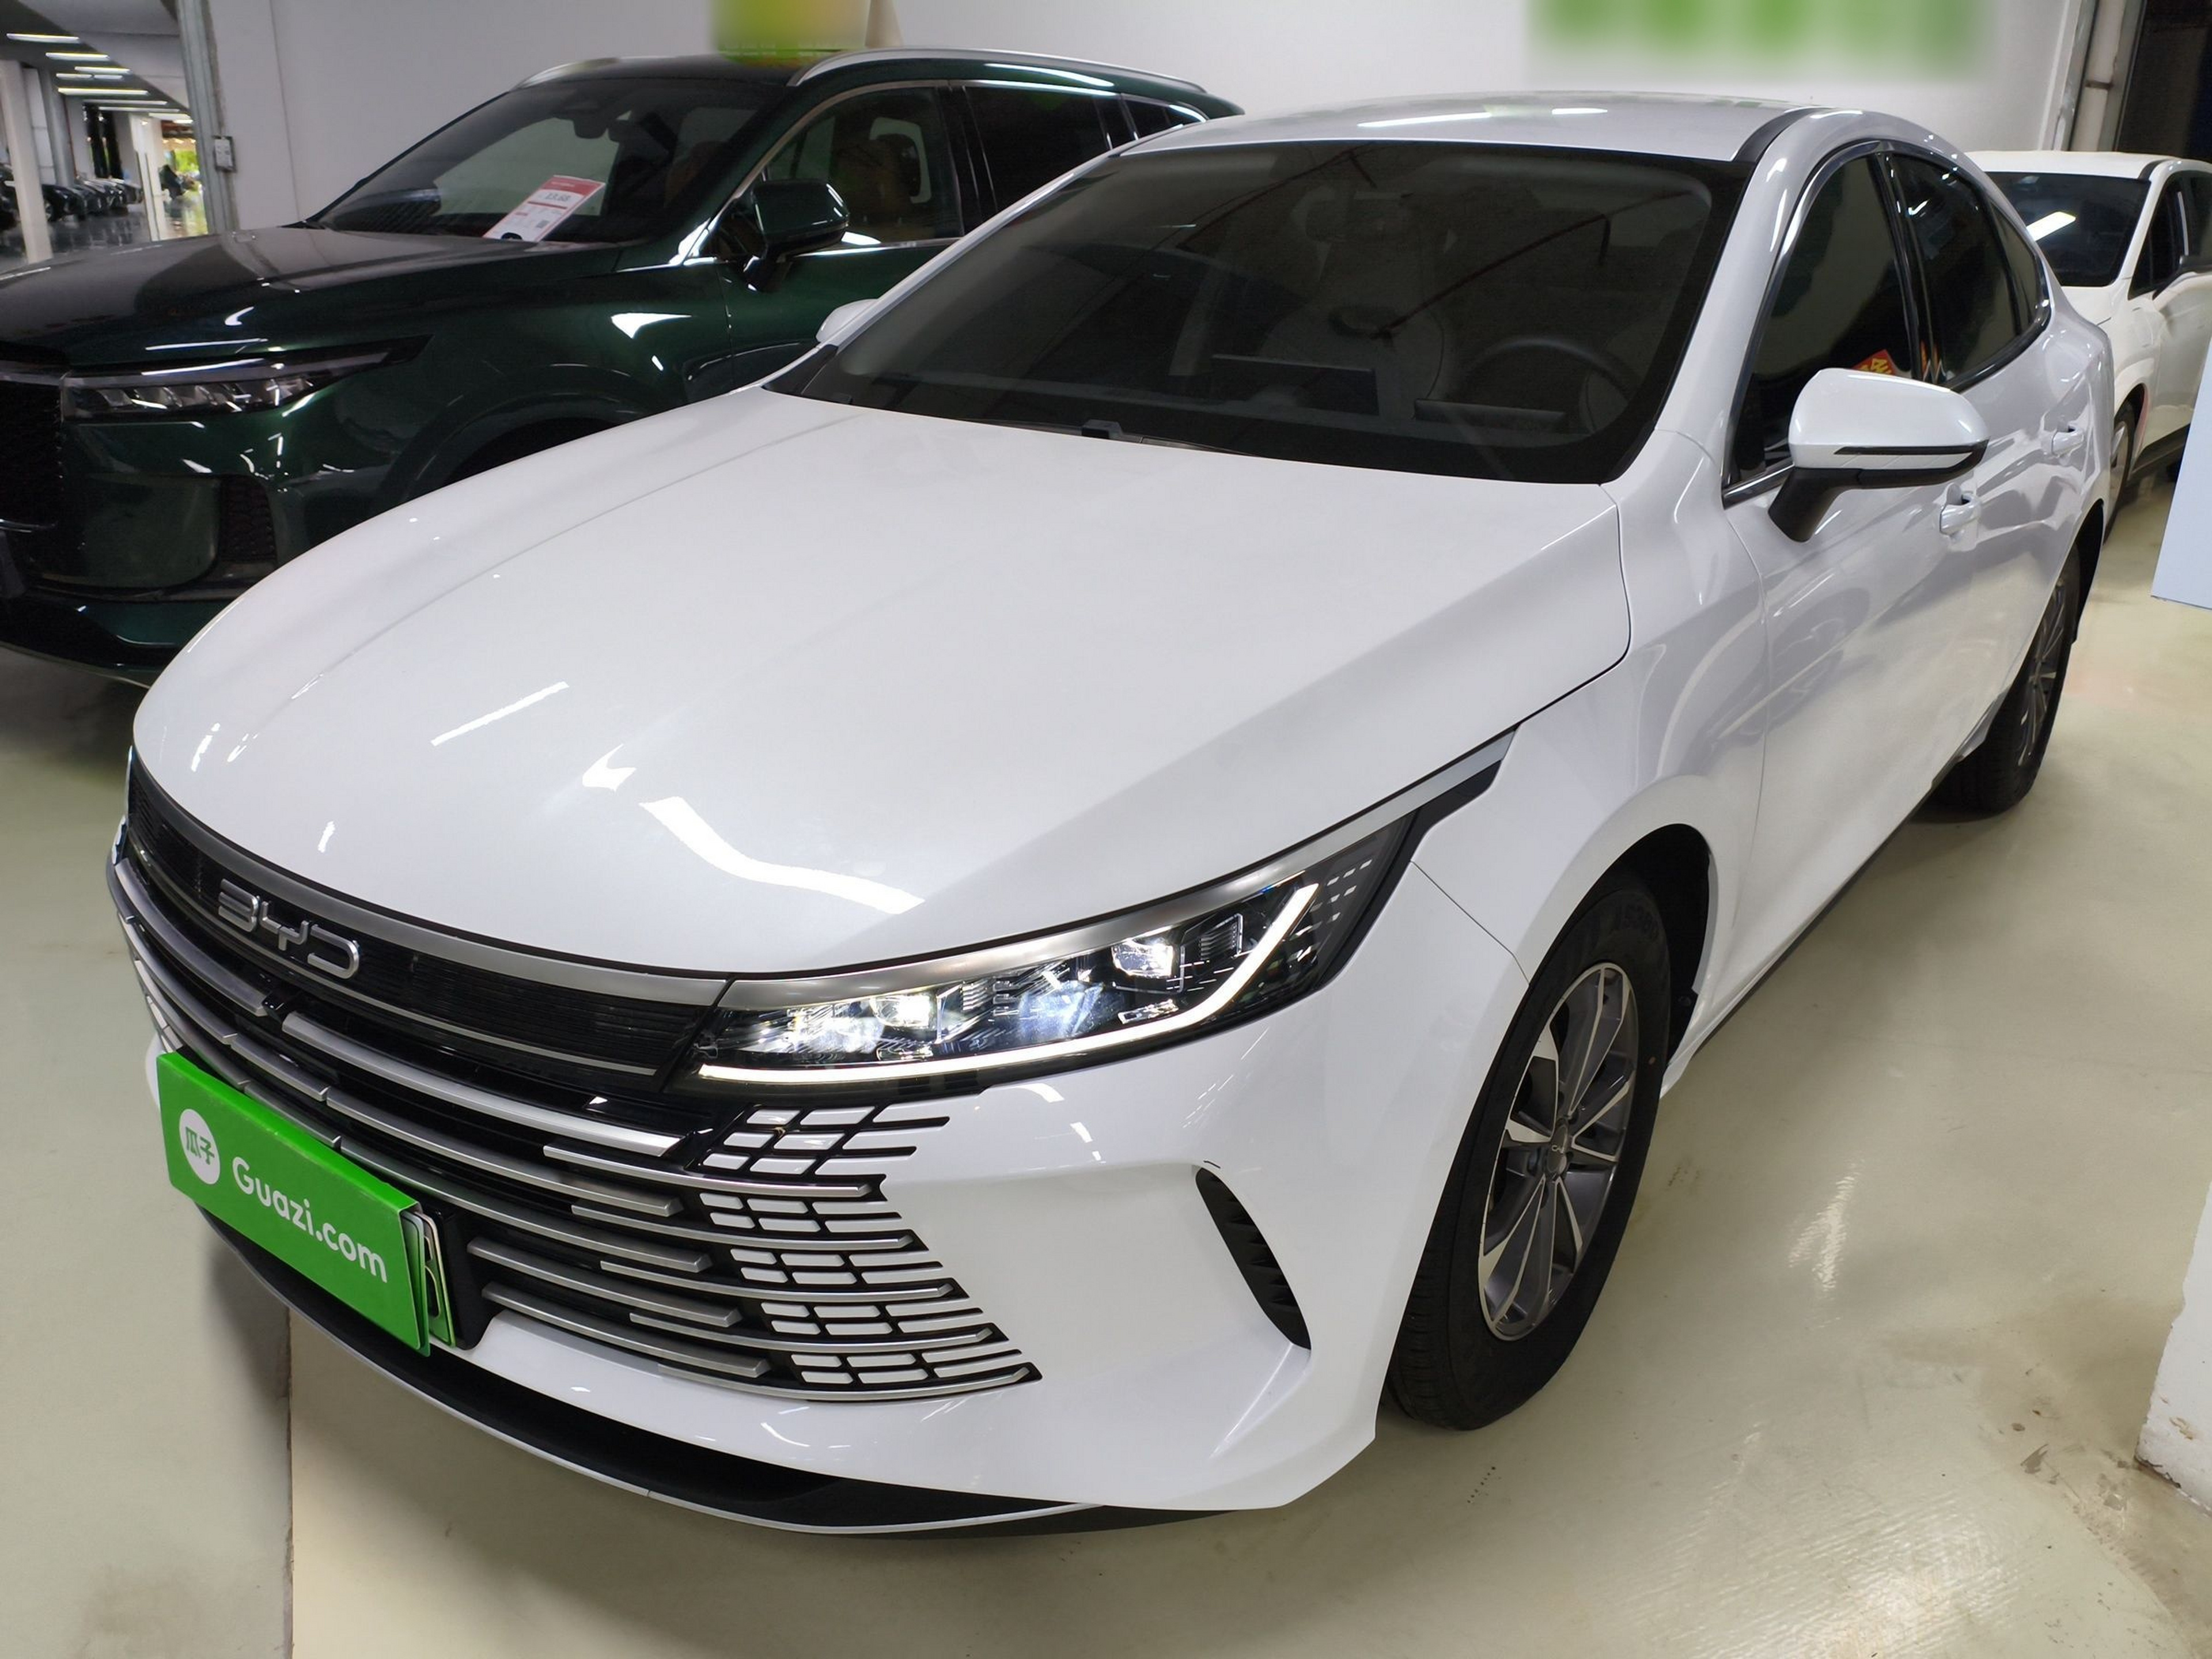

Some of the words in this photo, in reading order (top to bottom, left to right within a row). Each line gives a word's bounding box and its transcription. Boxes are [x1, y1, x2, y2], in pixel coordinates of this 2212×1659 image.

[218, 878, 359, 980] BYD
[185, 1126, 215, 1165] 瓜子
[232, 1157, 387, 1283] Guazi.com
